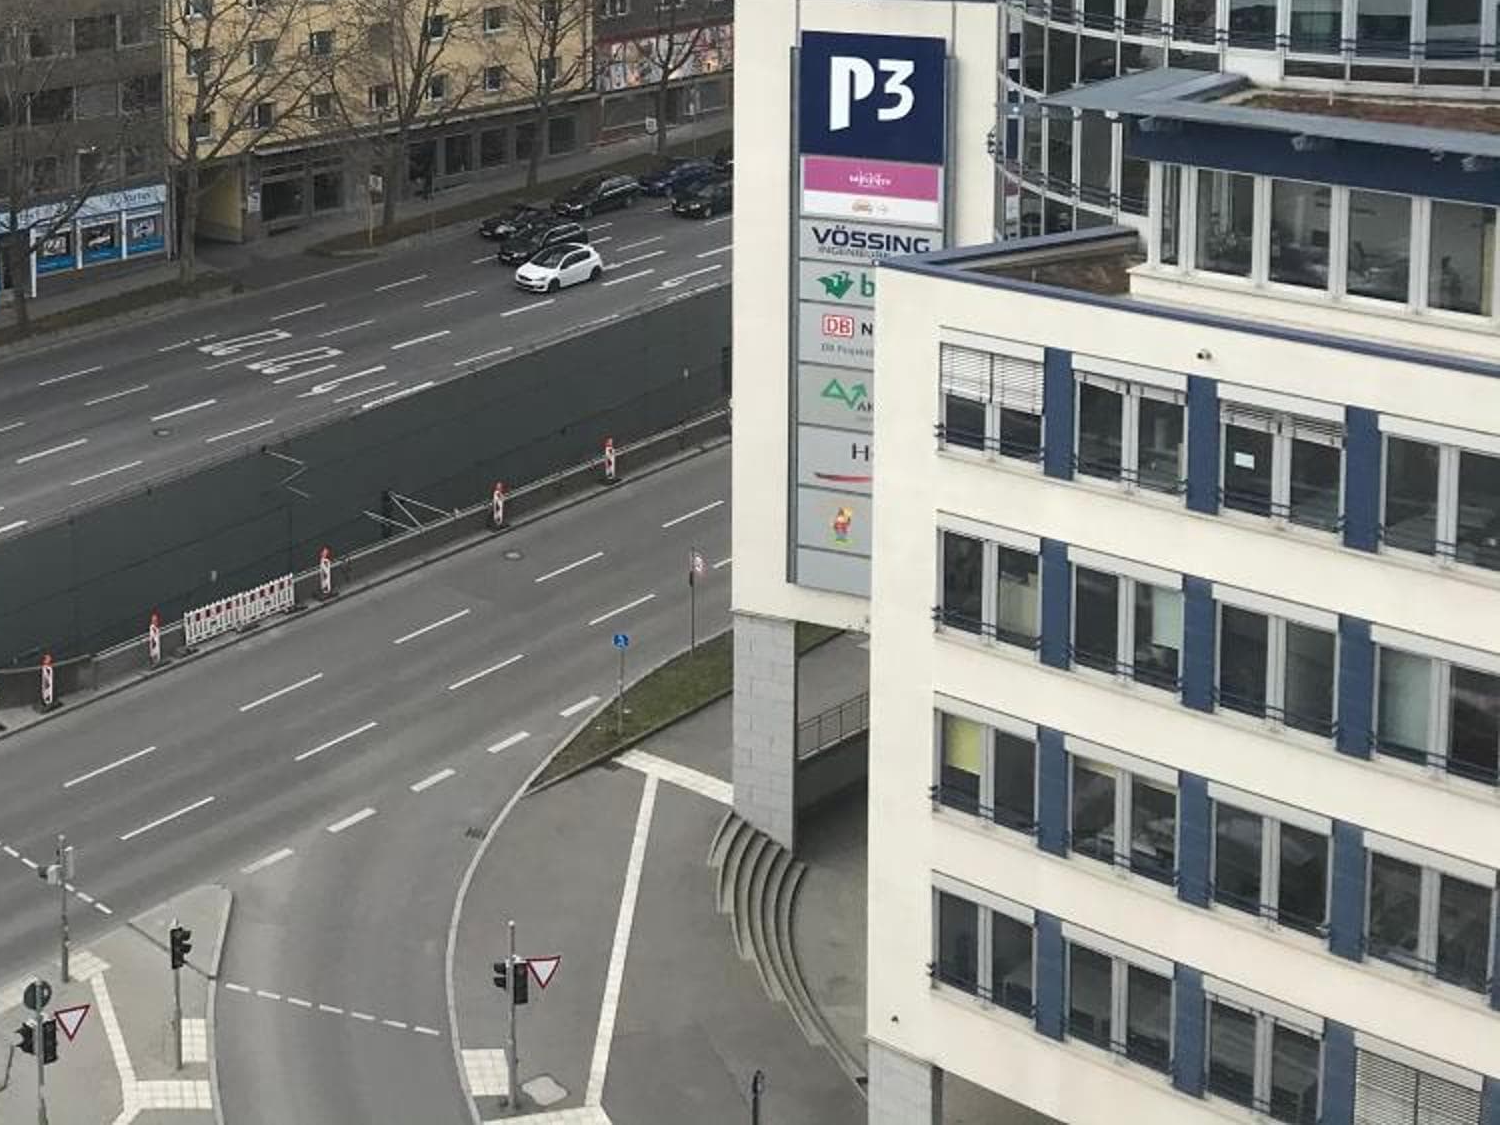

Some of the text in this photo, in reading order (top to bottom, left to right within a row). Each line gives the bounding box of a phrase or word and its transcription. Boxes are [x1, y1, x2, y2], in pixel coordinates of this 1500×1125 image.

[830, 56, 915, 131] P3
[812, 225, 930, 253] VÖSSING
[825, 317, 852, 335] DB
